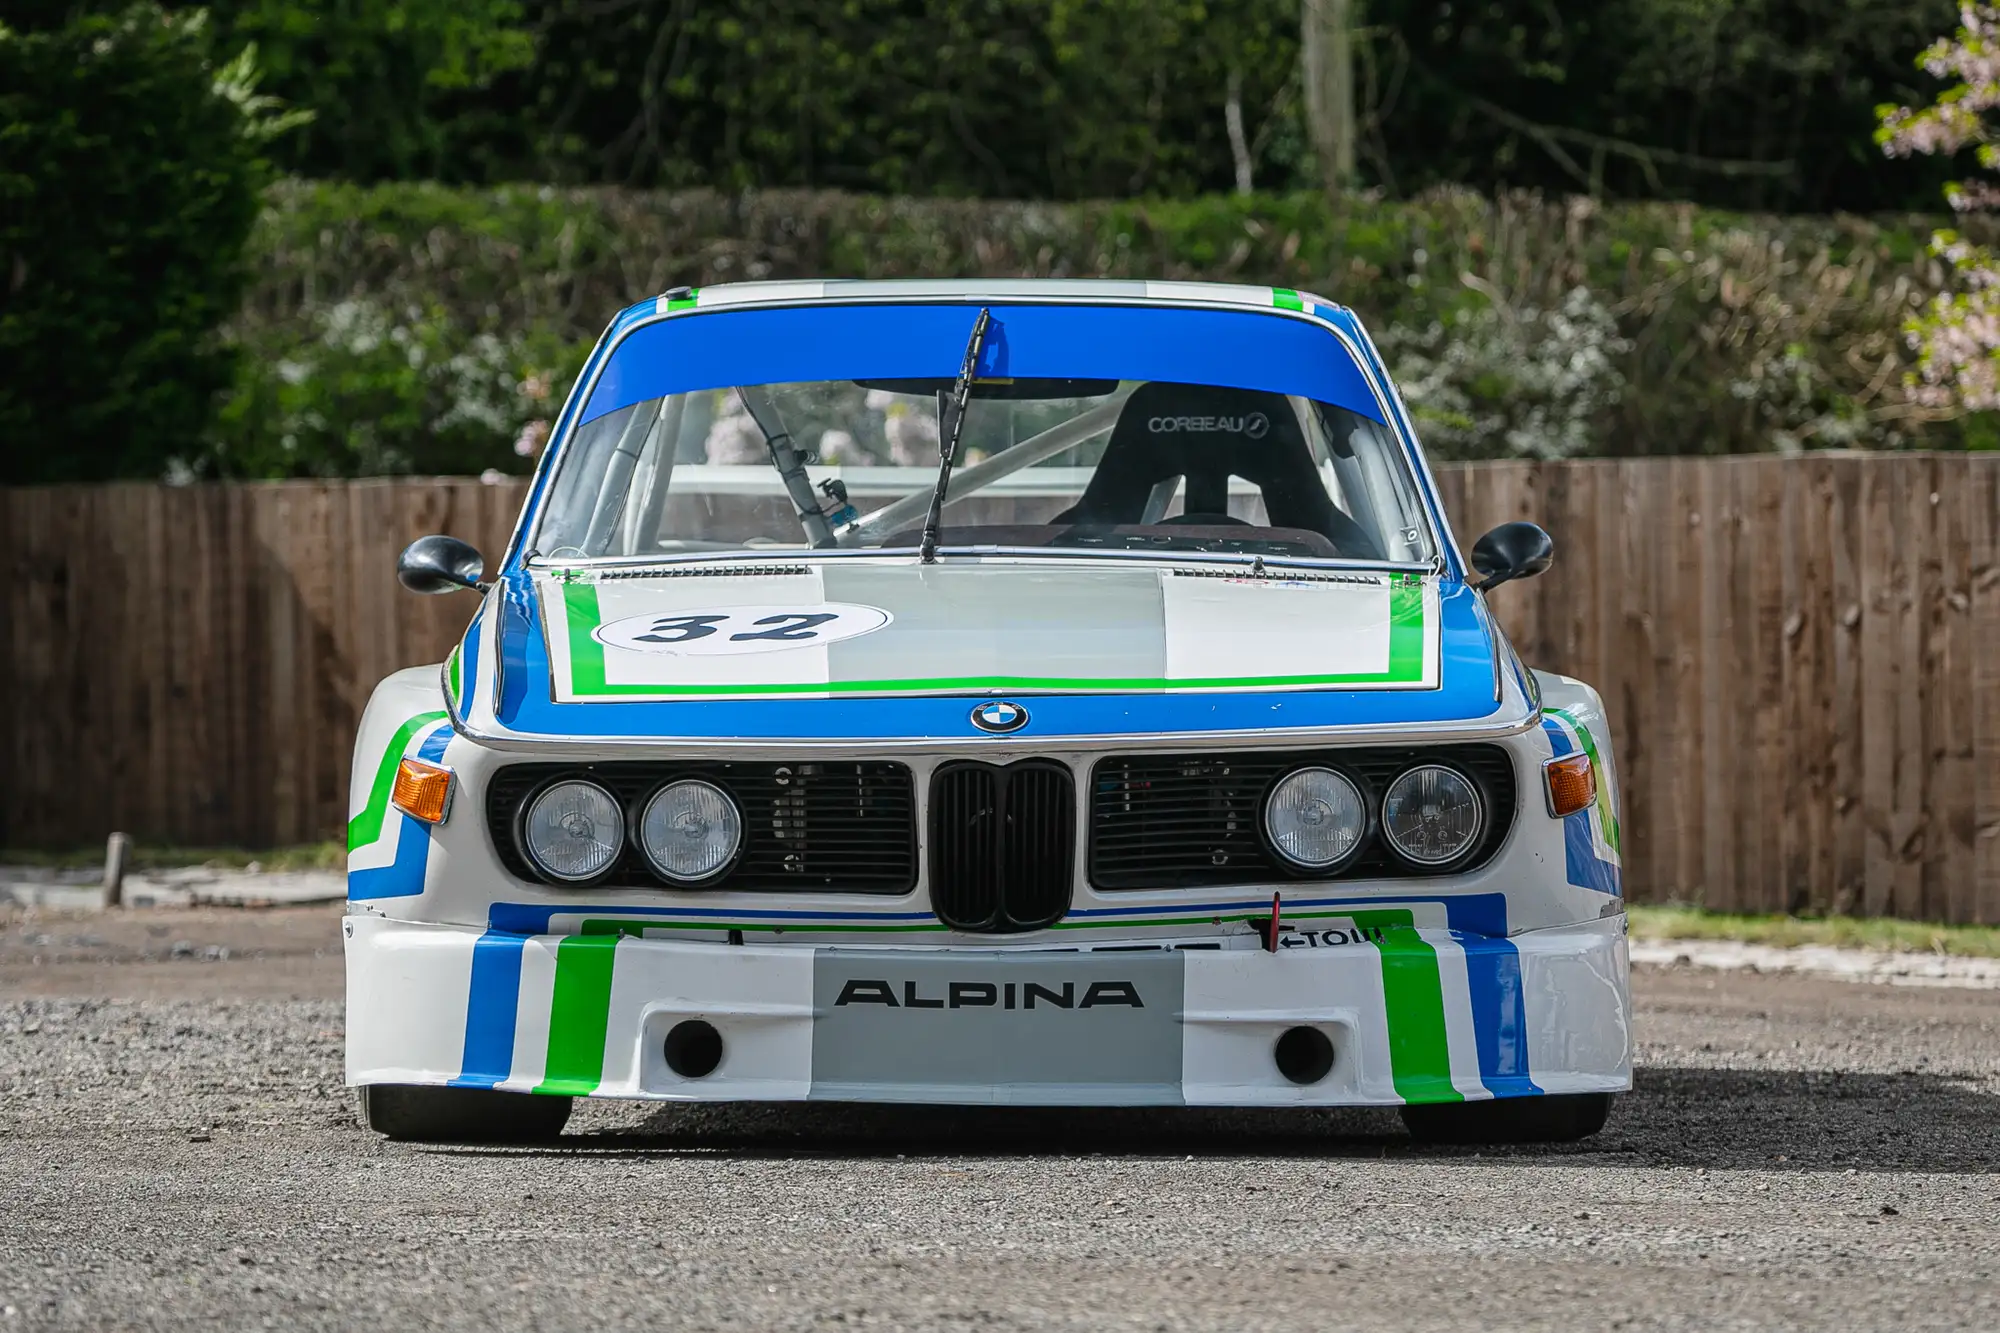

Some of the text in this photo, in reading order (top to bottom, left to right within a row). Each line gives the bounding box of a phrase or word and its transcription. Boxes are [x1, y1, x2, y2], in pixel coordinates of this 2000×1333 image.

[1147, 416, 1244, 433] CORBEAU
[631, 613, 840, 643] 32
[833, 979, 1146, 1010] ALPINA
